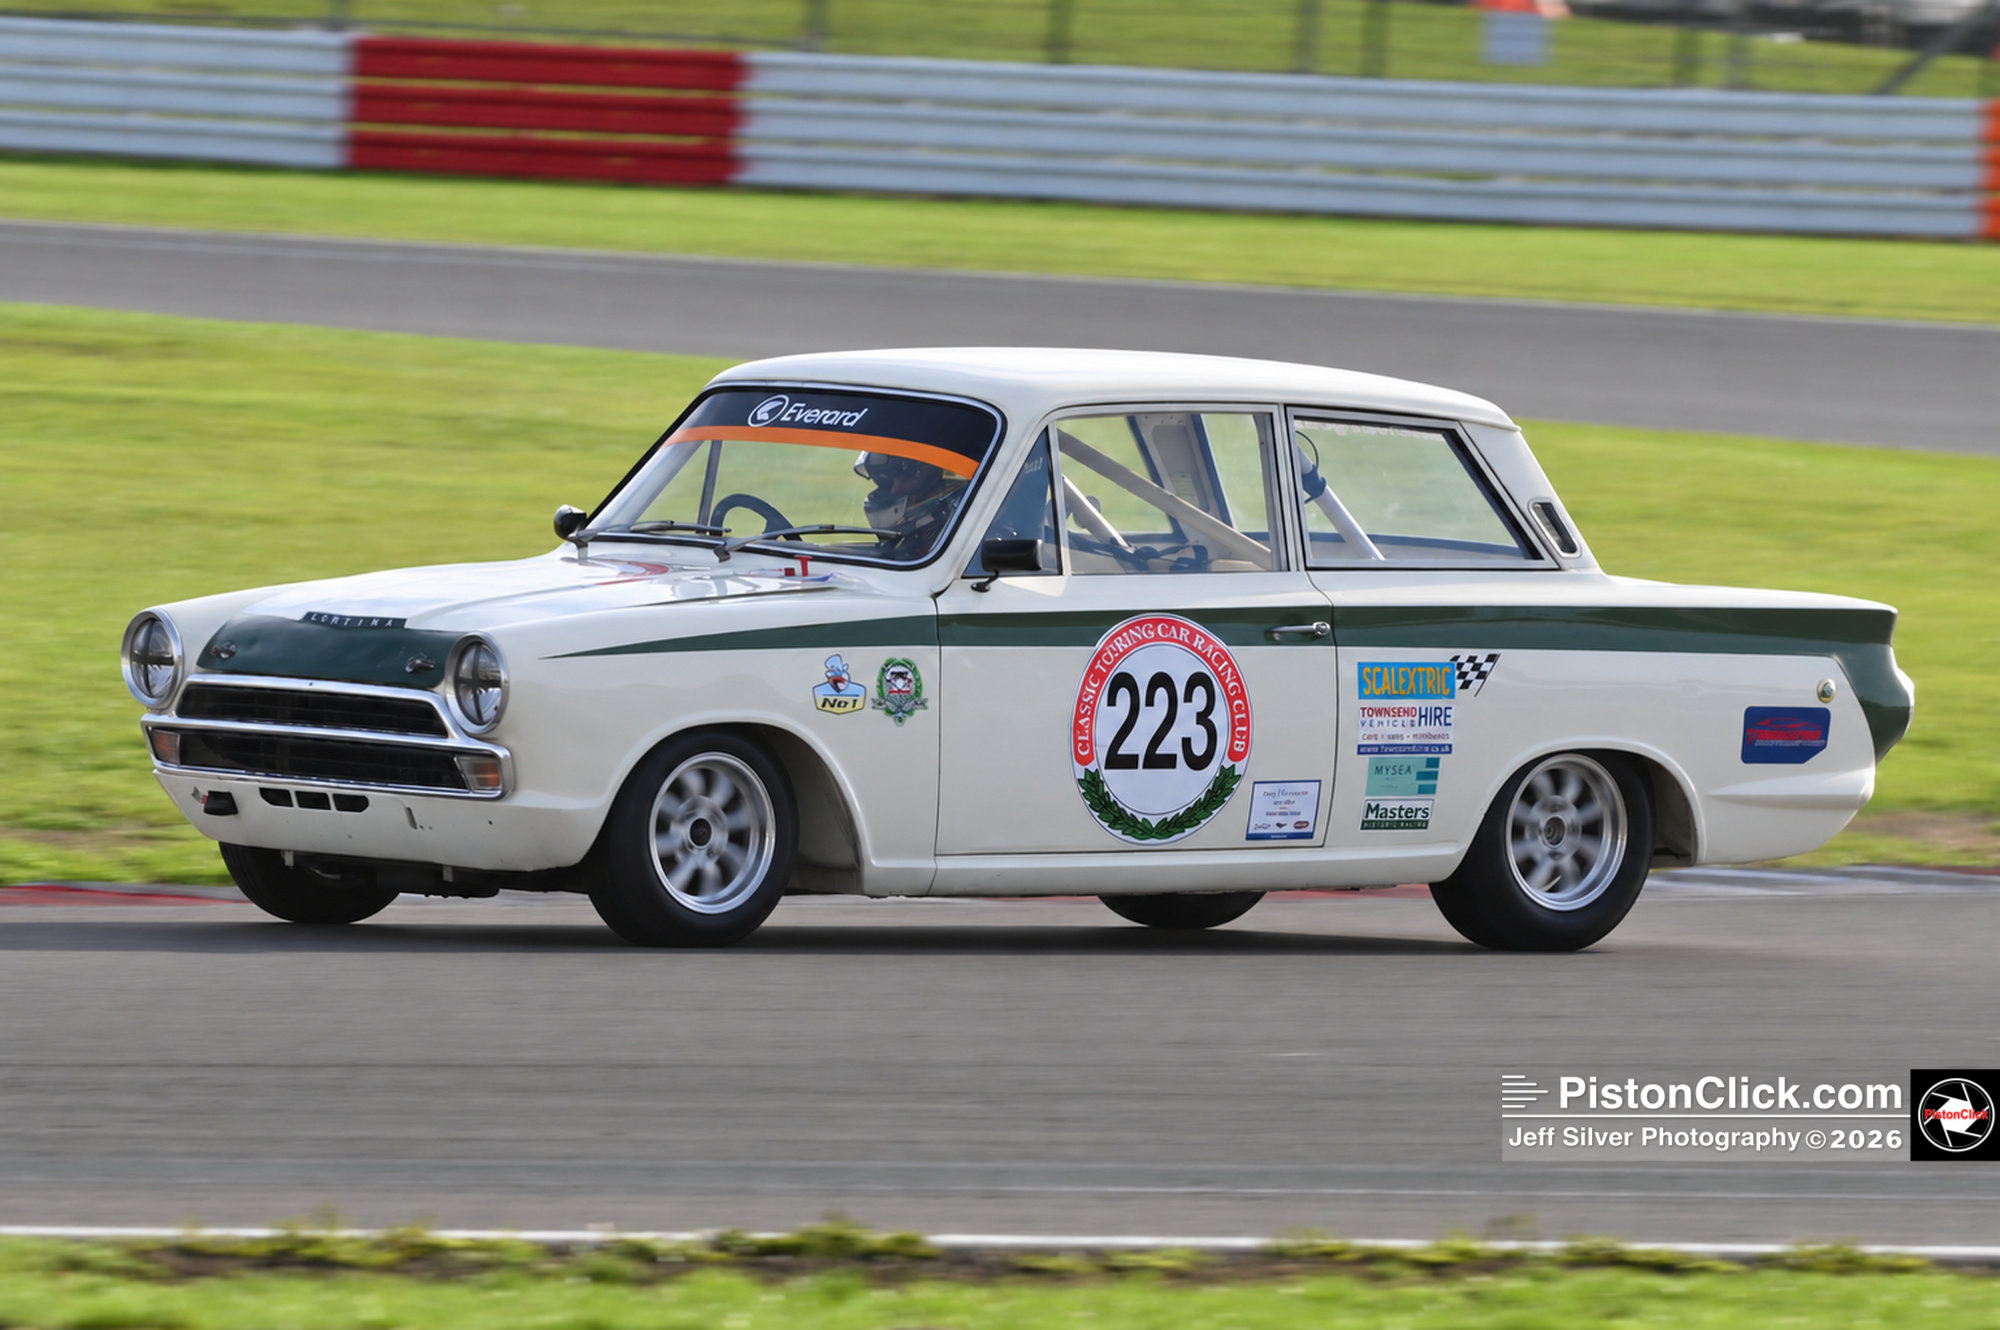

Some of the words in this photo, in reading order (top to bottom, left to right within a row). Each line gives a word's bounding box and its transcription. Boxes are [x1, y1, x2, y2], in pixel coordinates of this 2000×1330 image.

[780, 402, 869, 427] Everard
[1077, 674, 1100, 756] CLASSIC
[1095, 623, 1155, 673] TOURING
[1157, 623, 1190, 644] CAR
[1193, 635, 1241, 697] RACING
[1232, 700, 1247, 753] CLUB
[1362, 666, 1451, 695] SCALEXTRIC
[1104, 671, 1218, 771] 223
[1418, 706, 1453, 727] HIRE
[1374, 765, 1411, 776] MYSEA
[1365, 802, 1430, 819] Masters
